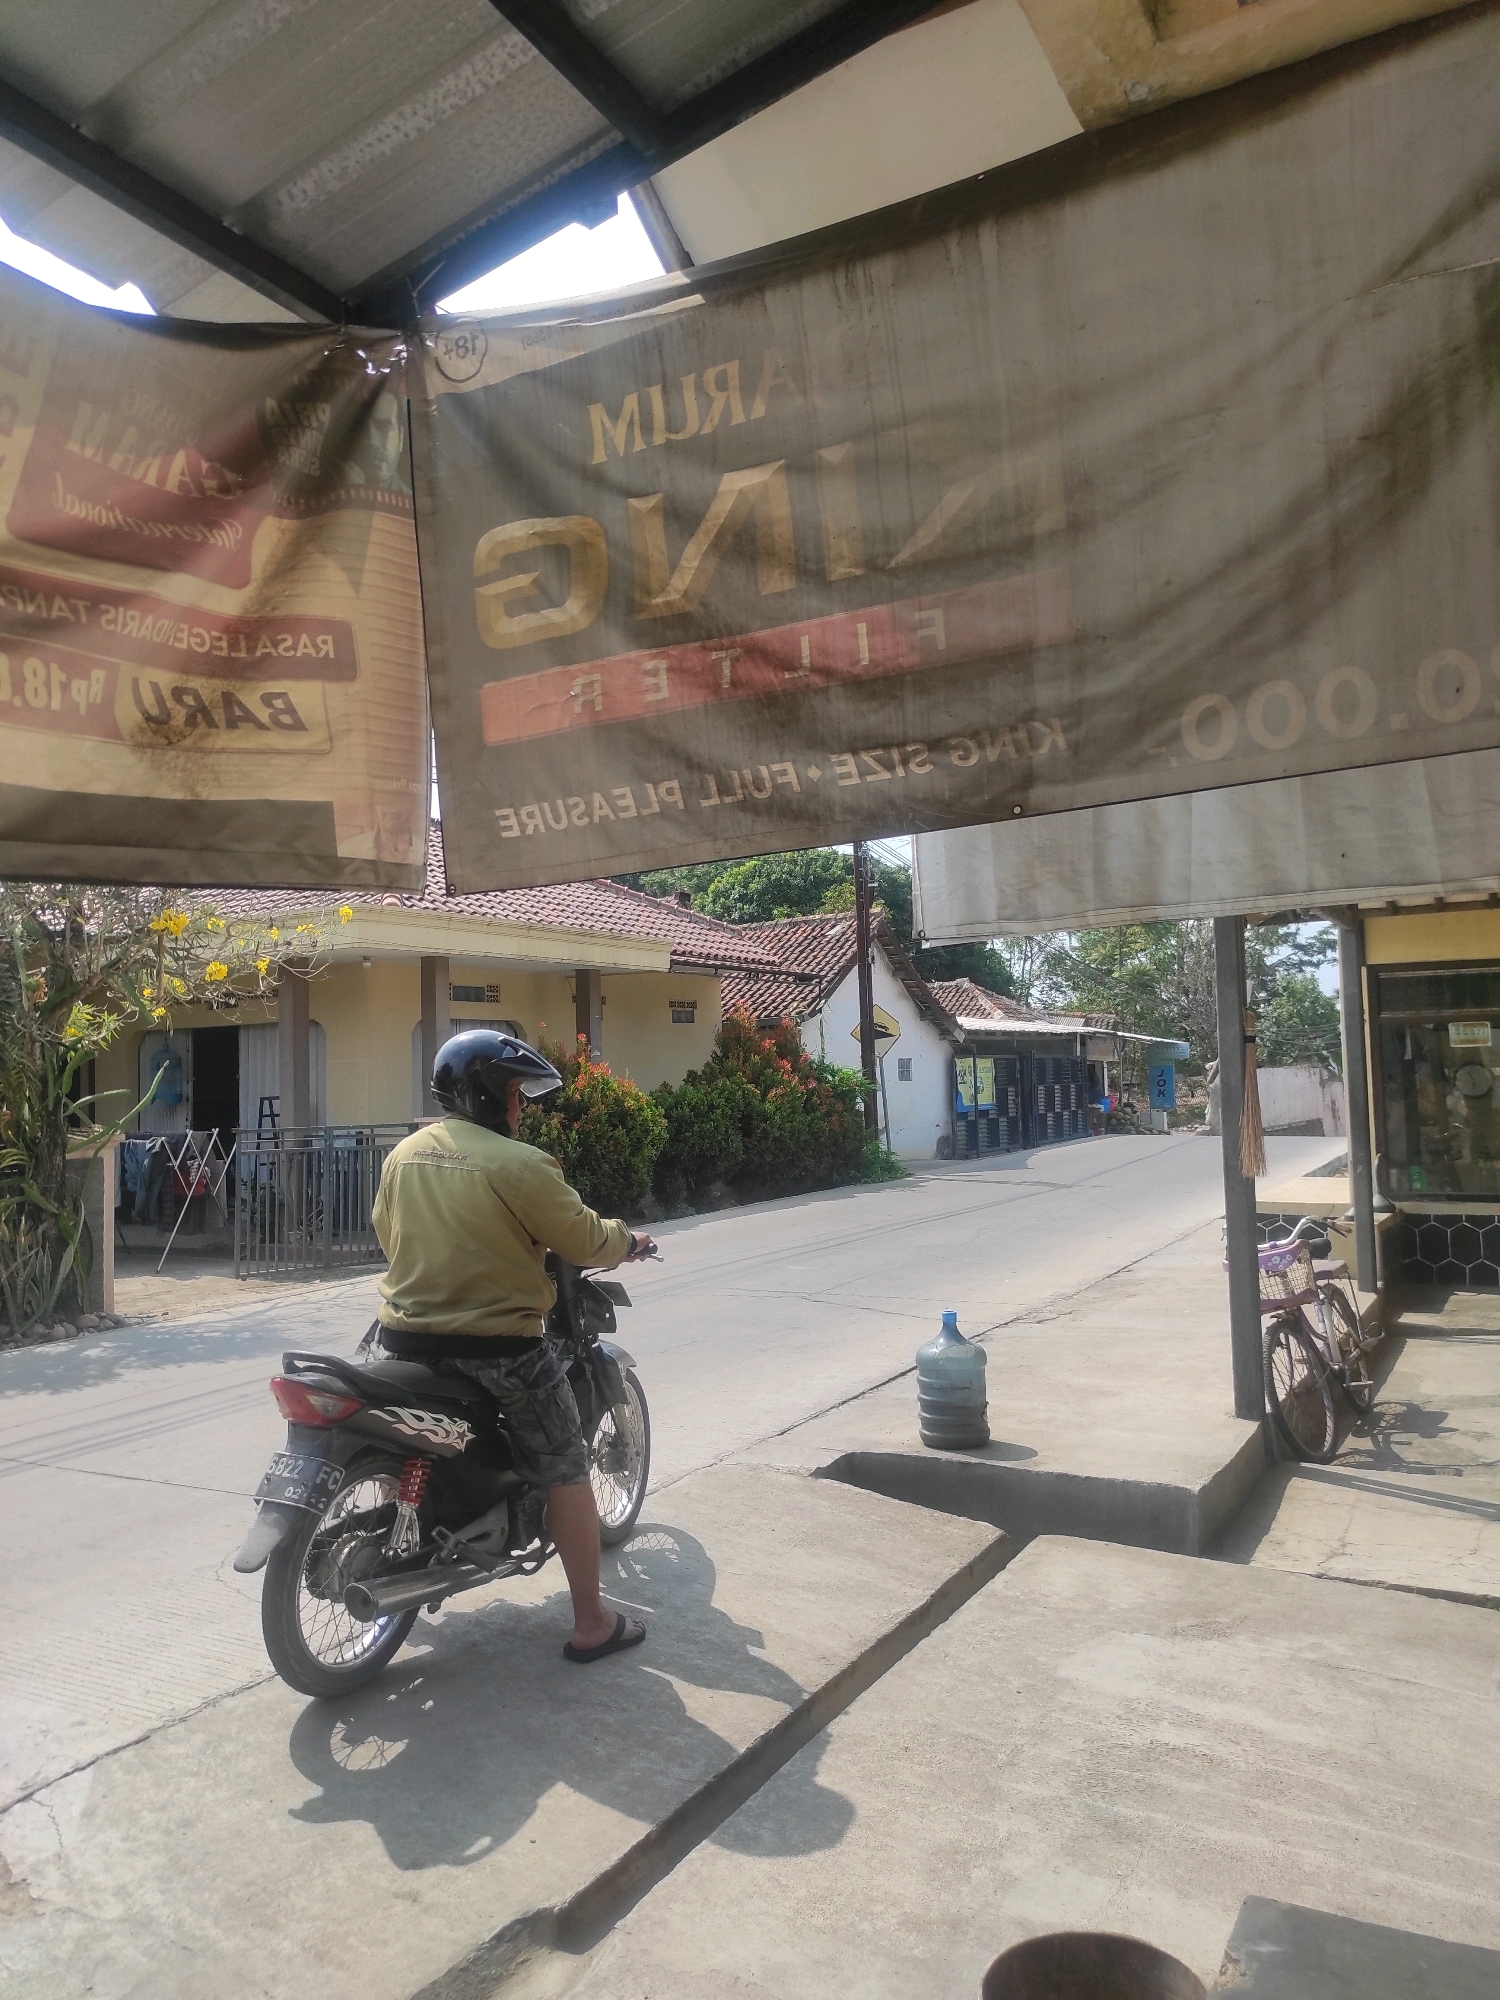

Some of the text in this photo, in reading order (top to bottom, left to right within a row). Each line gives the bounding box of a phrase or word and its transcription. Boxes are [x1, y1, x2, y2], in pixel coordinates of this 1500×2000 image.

[1156, 1068, 1167, 1098] JOK
[266, 1456, 341, 1491] 6822 FC
